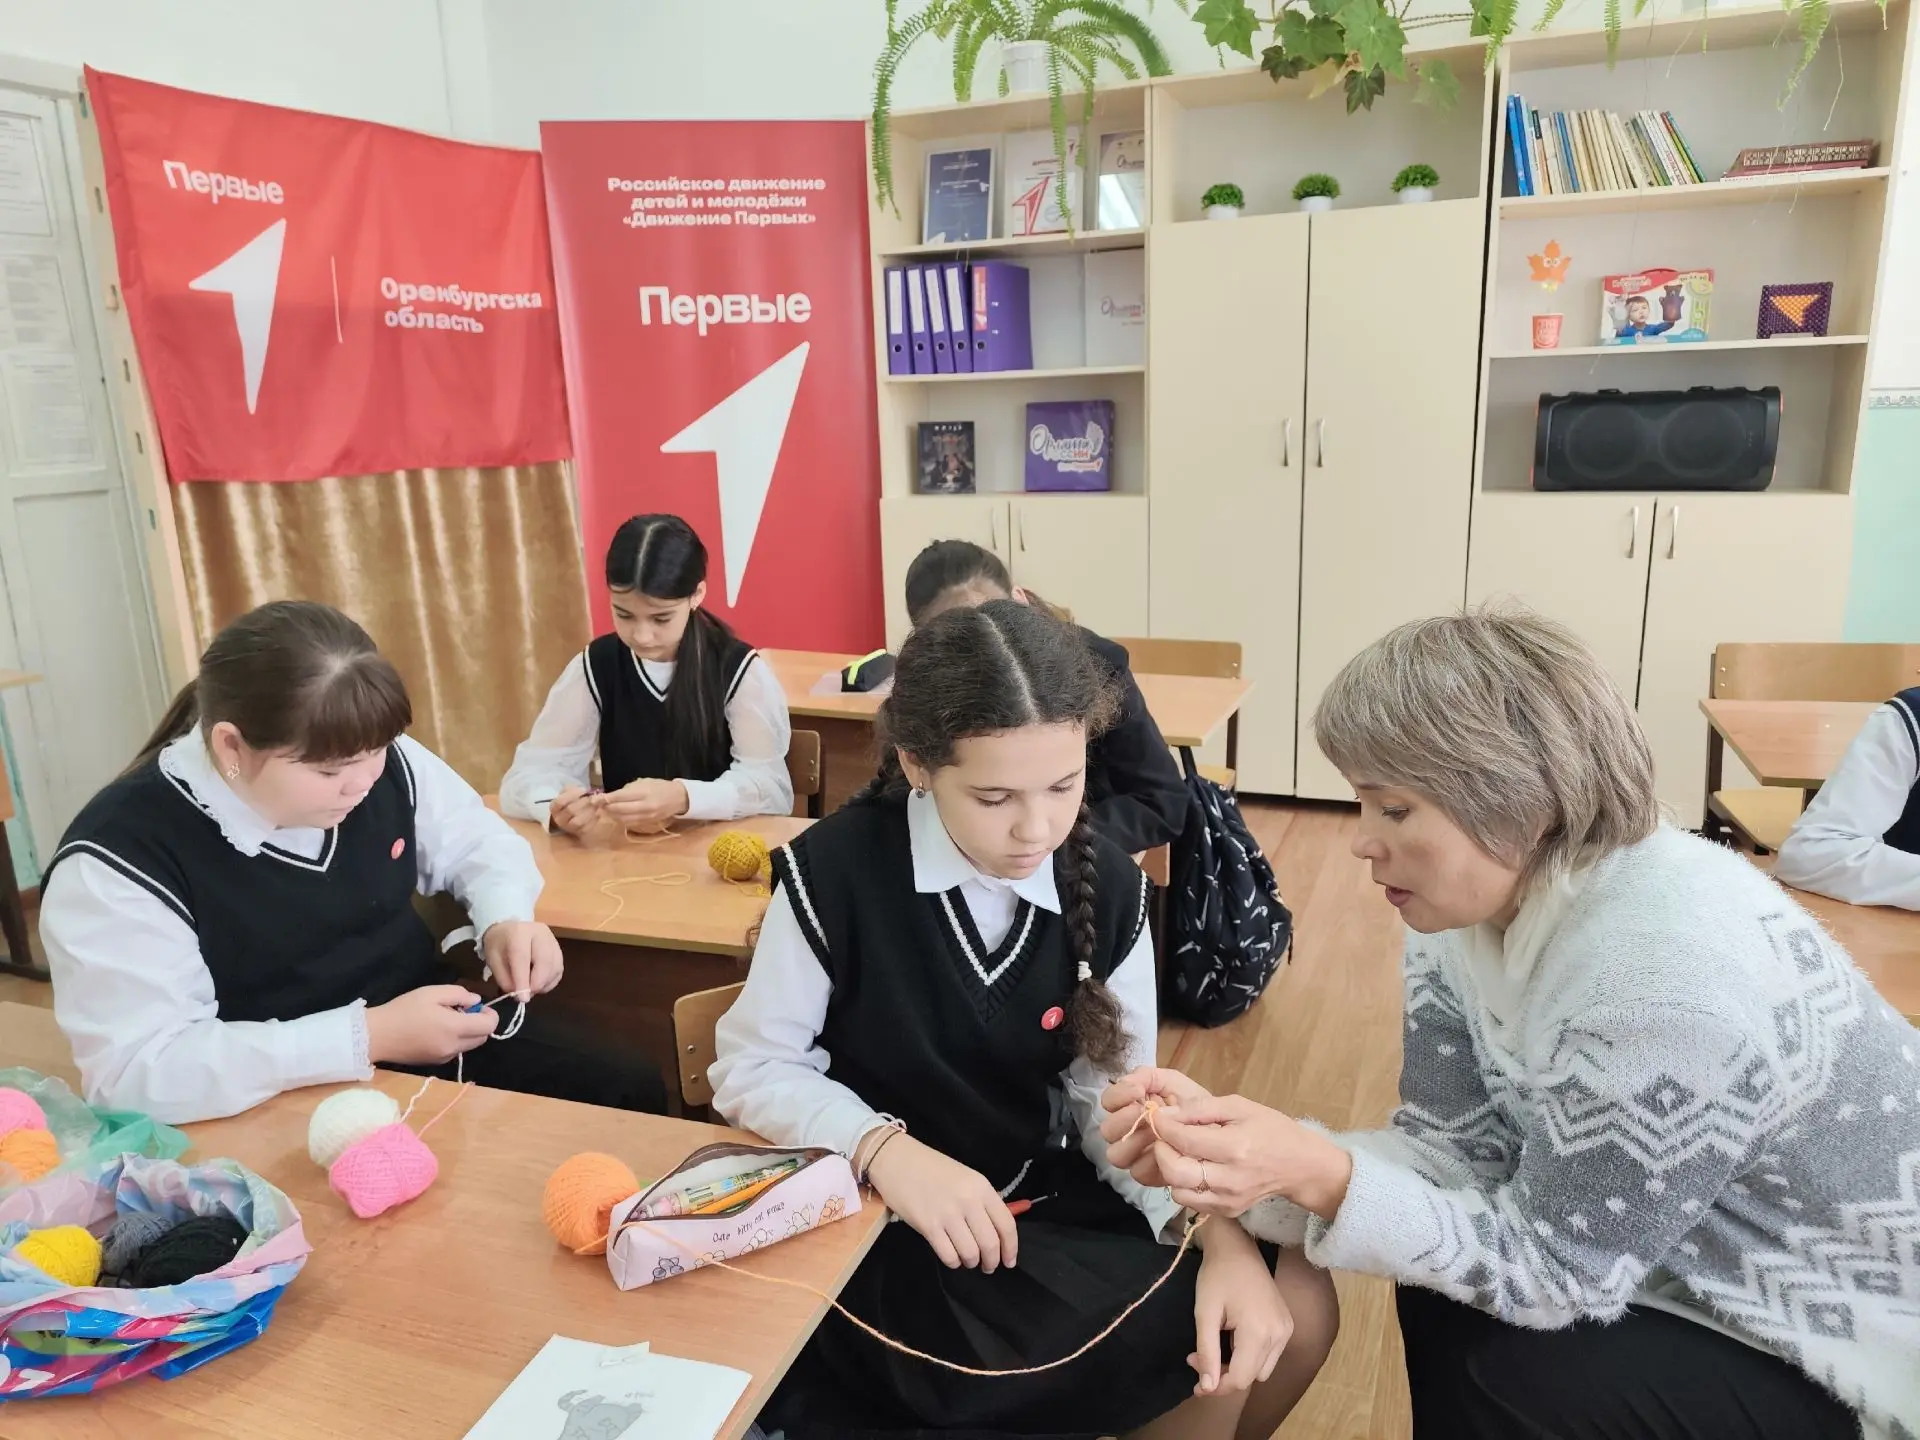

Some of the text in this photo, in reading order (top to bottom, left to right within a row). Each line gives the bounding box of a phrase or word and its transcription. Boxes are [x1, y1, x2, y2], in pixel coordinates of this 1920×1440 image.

[162, 159, 284, 205] Первые
[607, 176, 826, 192] Российское движение
[631, 193, 807, 210] детей и молодёжи
[623, 210, 816, 228] «Движение Первых»
[380, 276, 542, 312] Оренбургска
[384, 305, 484, 334] область
[639, 286, 812, 337] Первые
